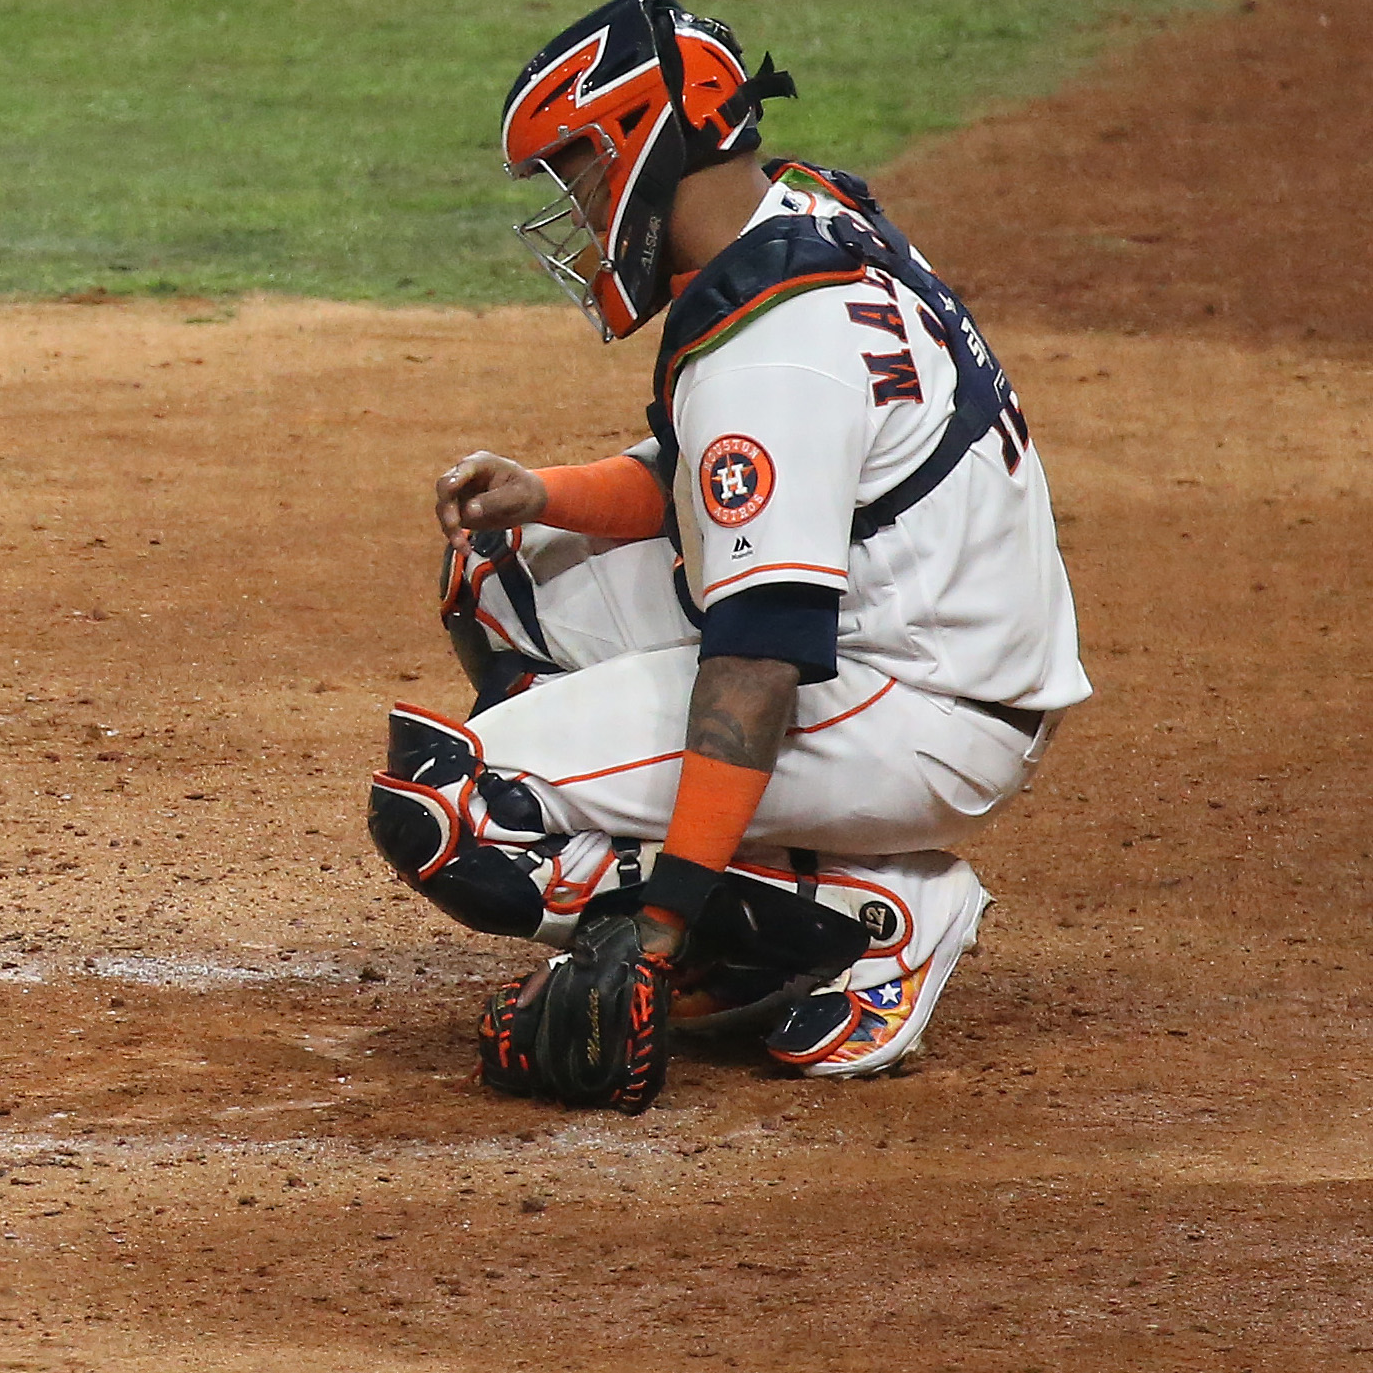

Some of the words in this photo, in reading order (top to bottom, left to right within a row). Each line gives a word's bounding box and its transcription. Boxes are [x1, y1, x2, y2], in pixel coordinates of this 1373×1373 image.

[702, 438, 760, 472] HOUSTON
[716, 463, 749, 500] H
[713, 493, 764, 522] ASTROS
